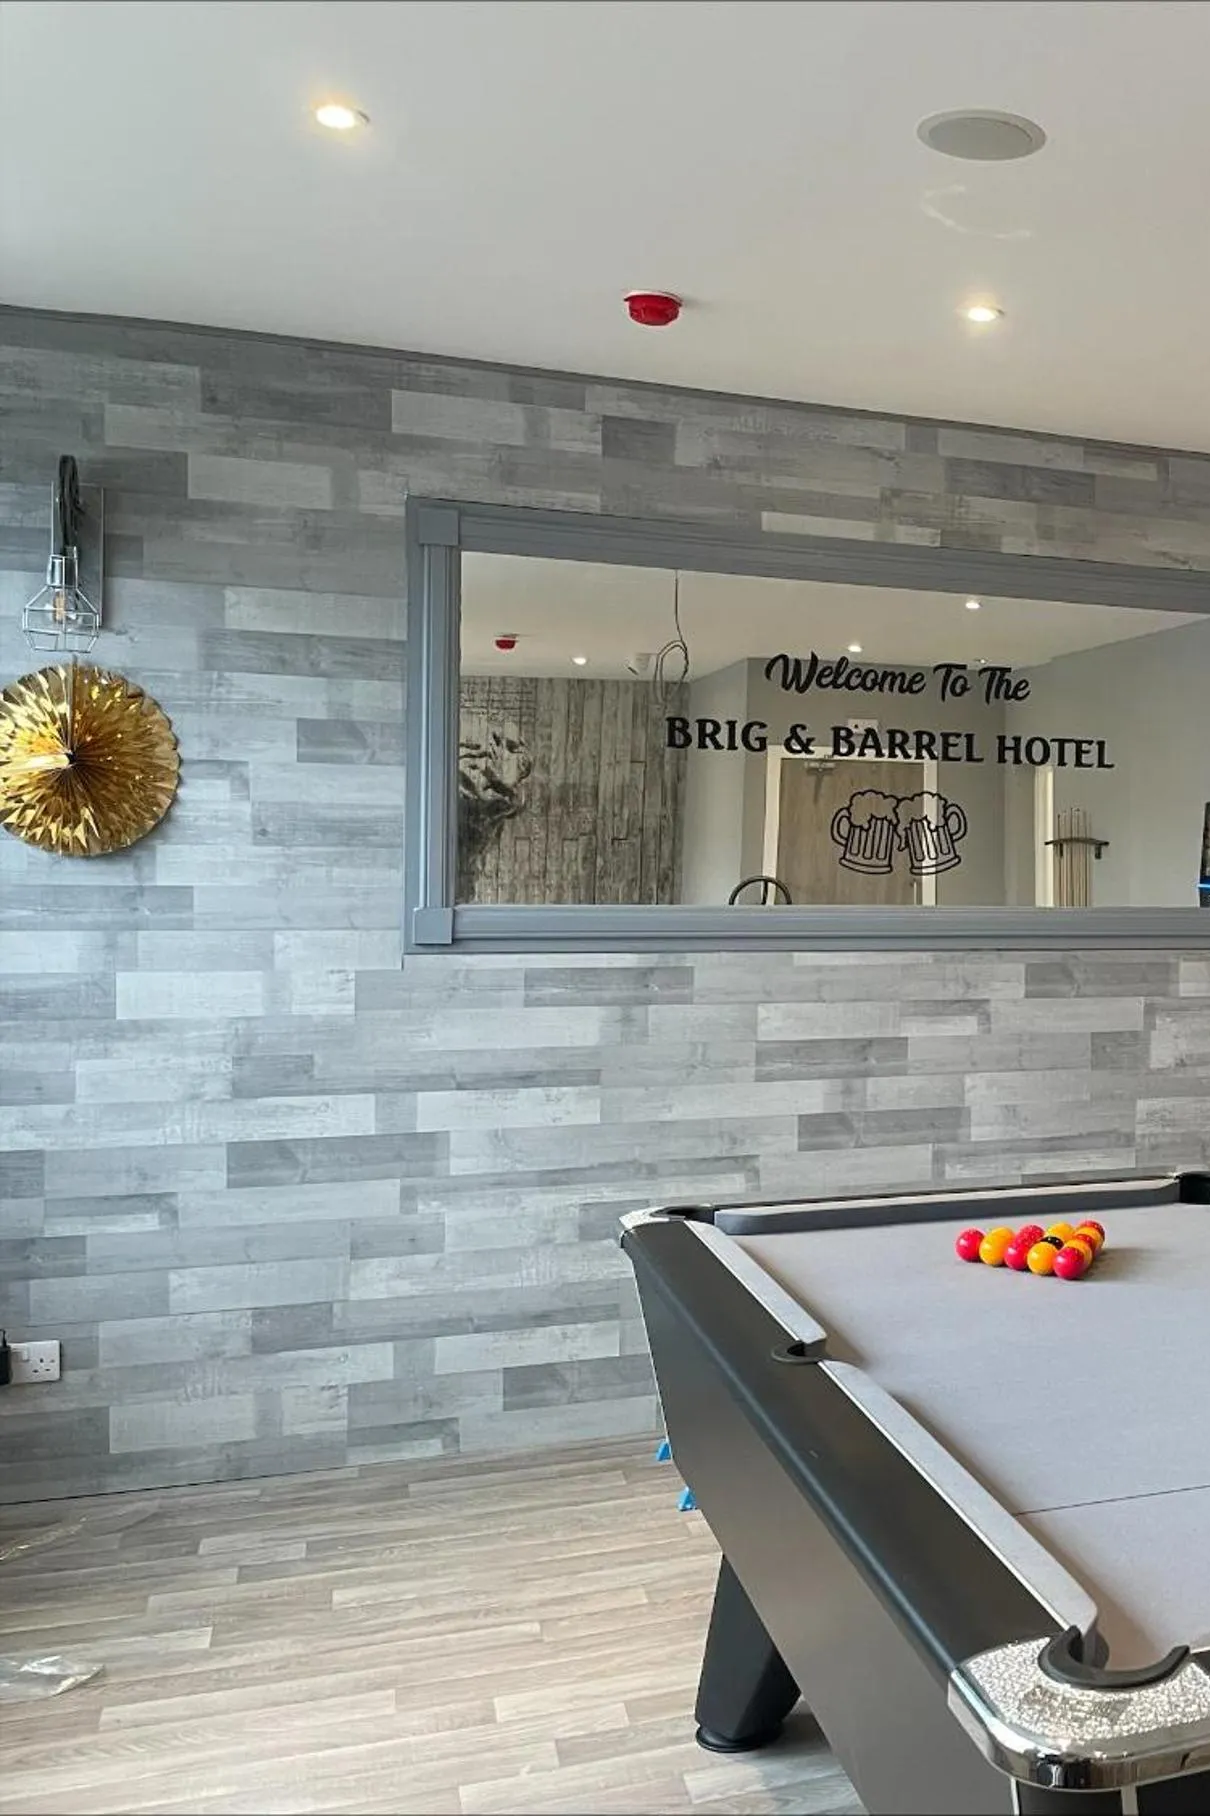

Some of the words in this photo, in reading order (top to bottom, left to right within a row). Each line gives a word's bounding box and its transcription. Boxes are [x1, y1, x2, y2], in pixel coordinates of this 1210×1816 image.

[765, 651, 926, 695] Welcome
[933, 663, 973, 703] To
[978, 666, 1031, 706] The
[665, 716, 768, 753] BRIG
[784, 723, 816, 755] &
[831, 726, 985, 763] BARREL
[996, 734, 1115, 769] HOTEL
